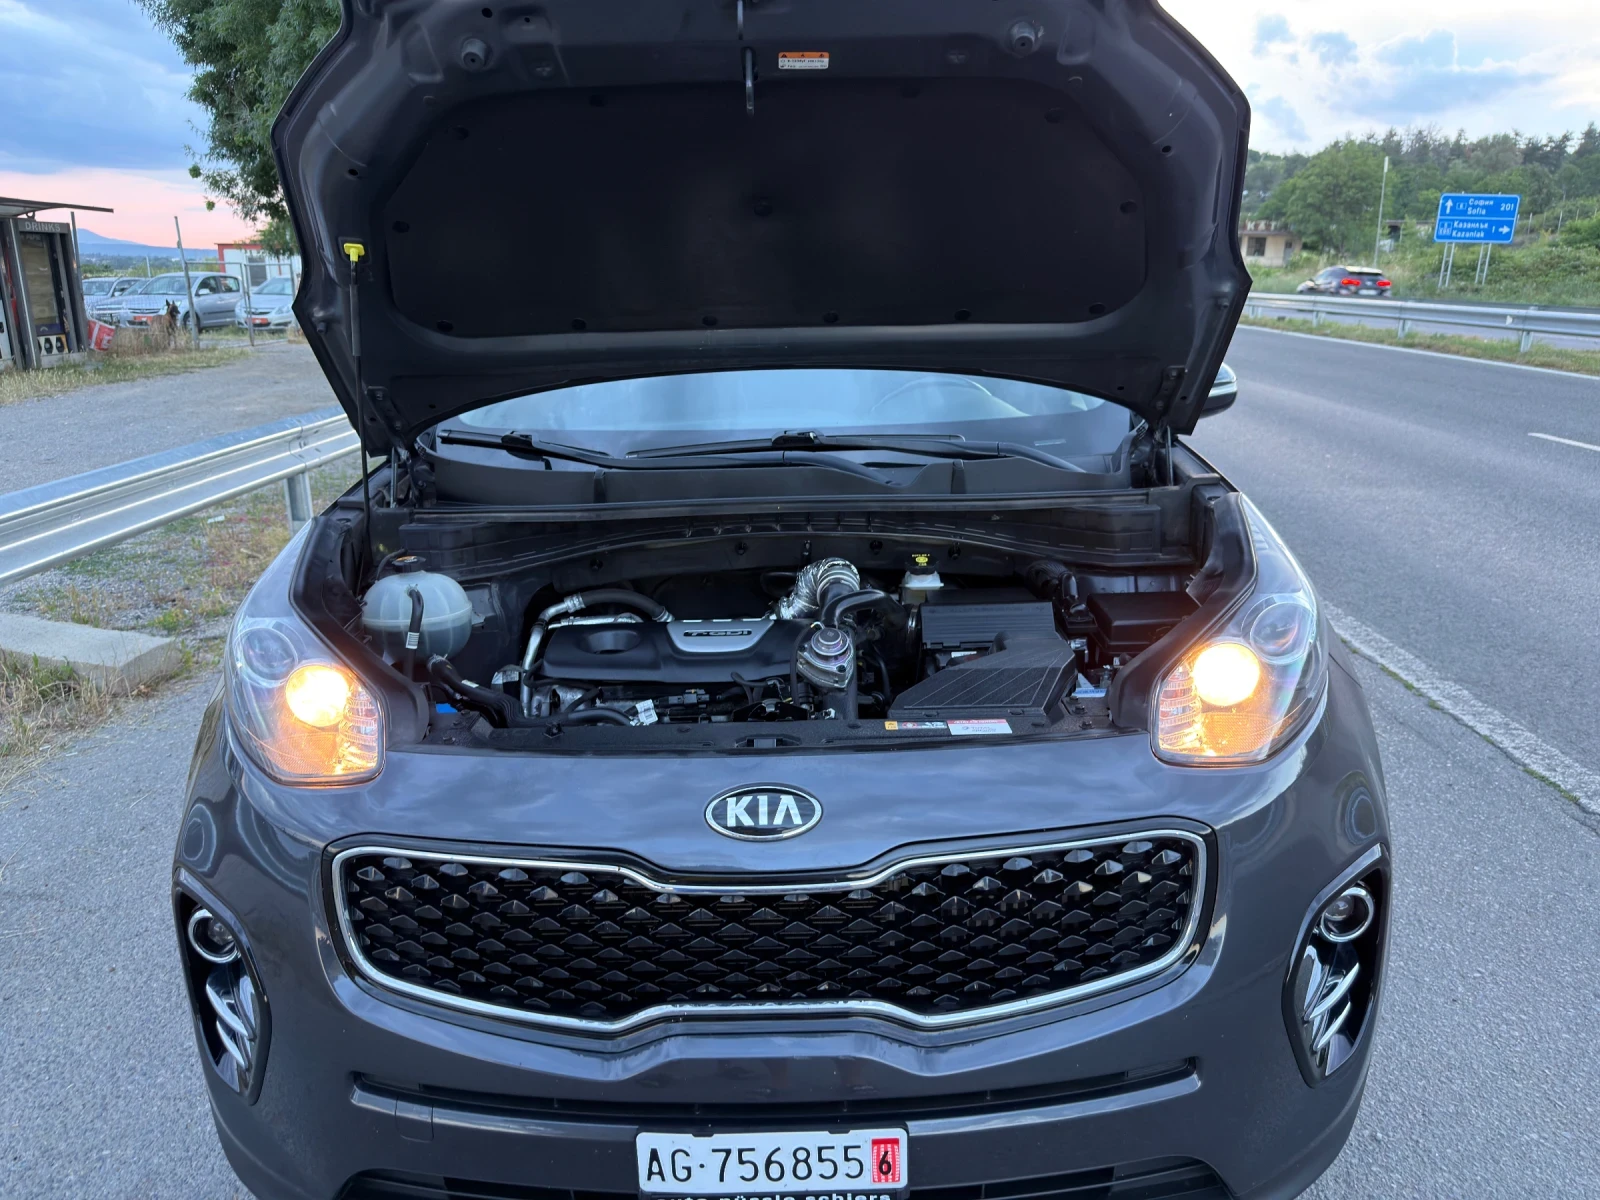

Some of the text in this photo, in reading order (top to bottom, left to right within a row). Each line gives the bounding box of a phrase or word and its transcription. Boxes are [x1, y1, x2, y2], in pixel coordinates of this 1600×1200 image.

[1468, 198, 1494, 206] София
[1467, 207, 1486, 215] Sofia
[1500, 203, 1514, 211] 201
[25, 221, 61, 232] DRINKS
[726, 794, 803, 827] KIA
[879, 1151, 892, 1175] 6
